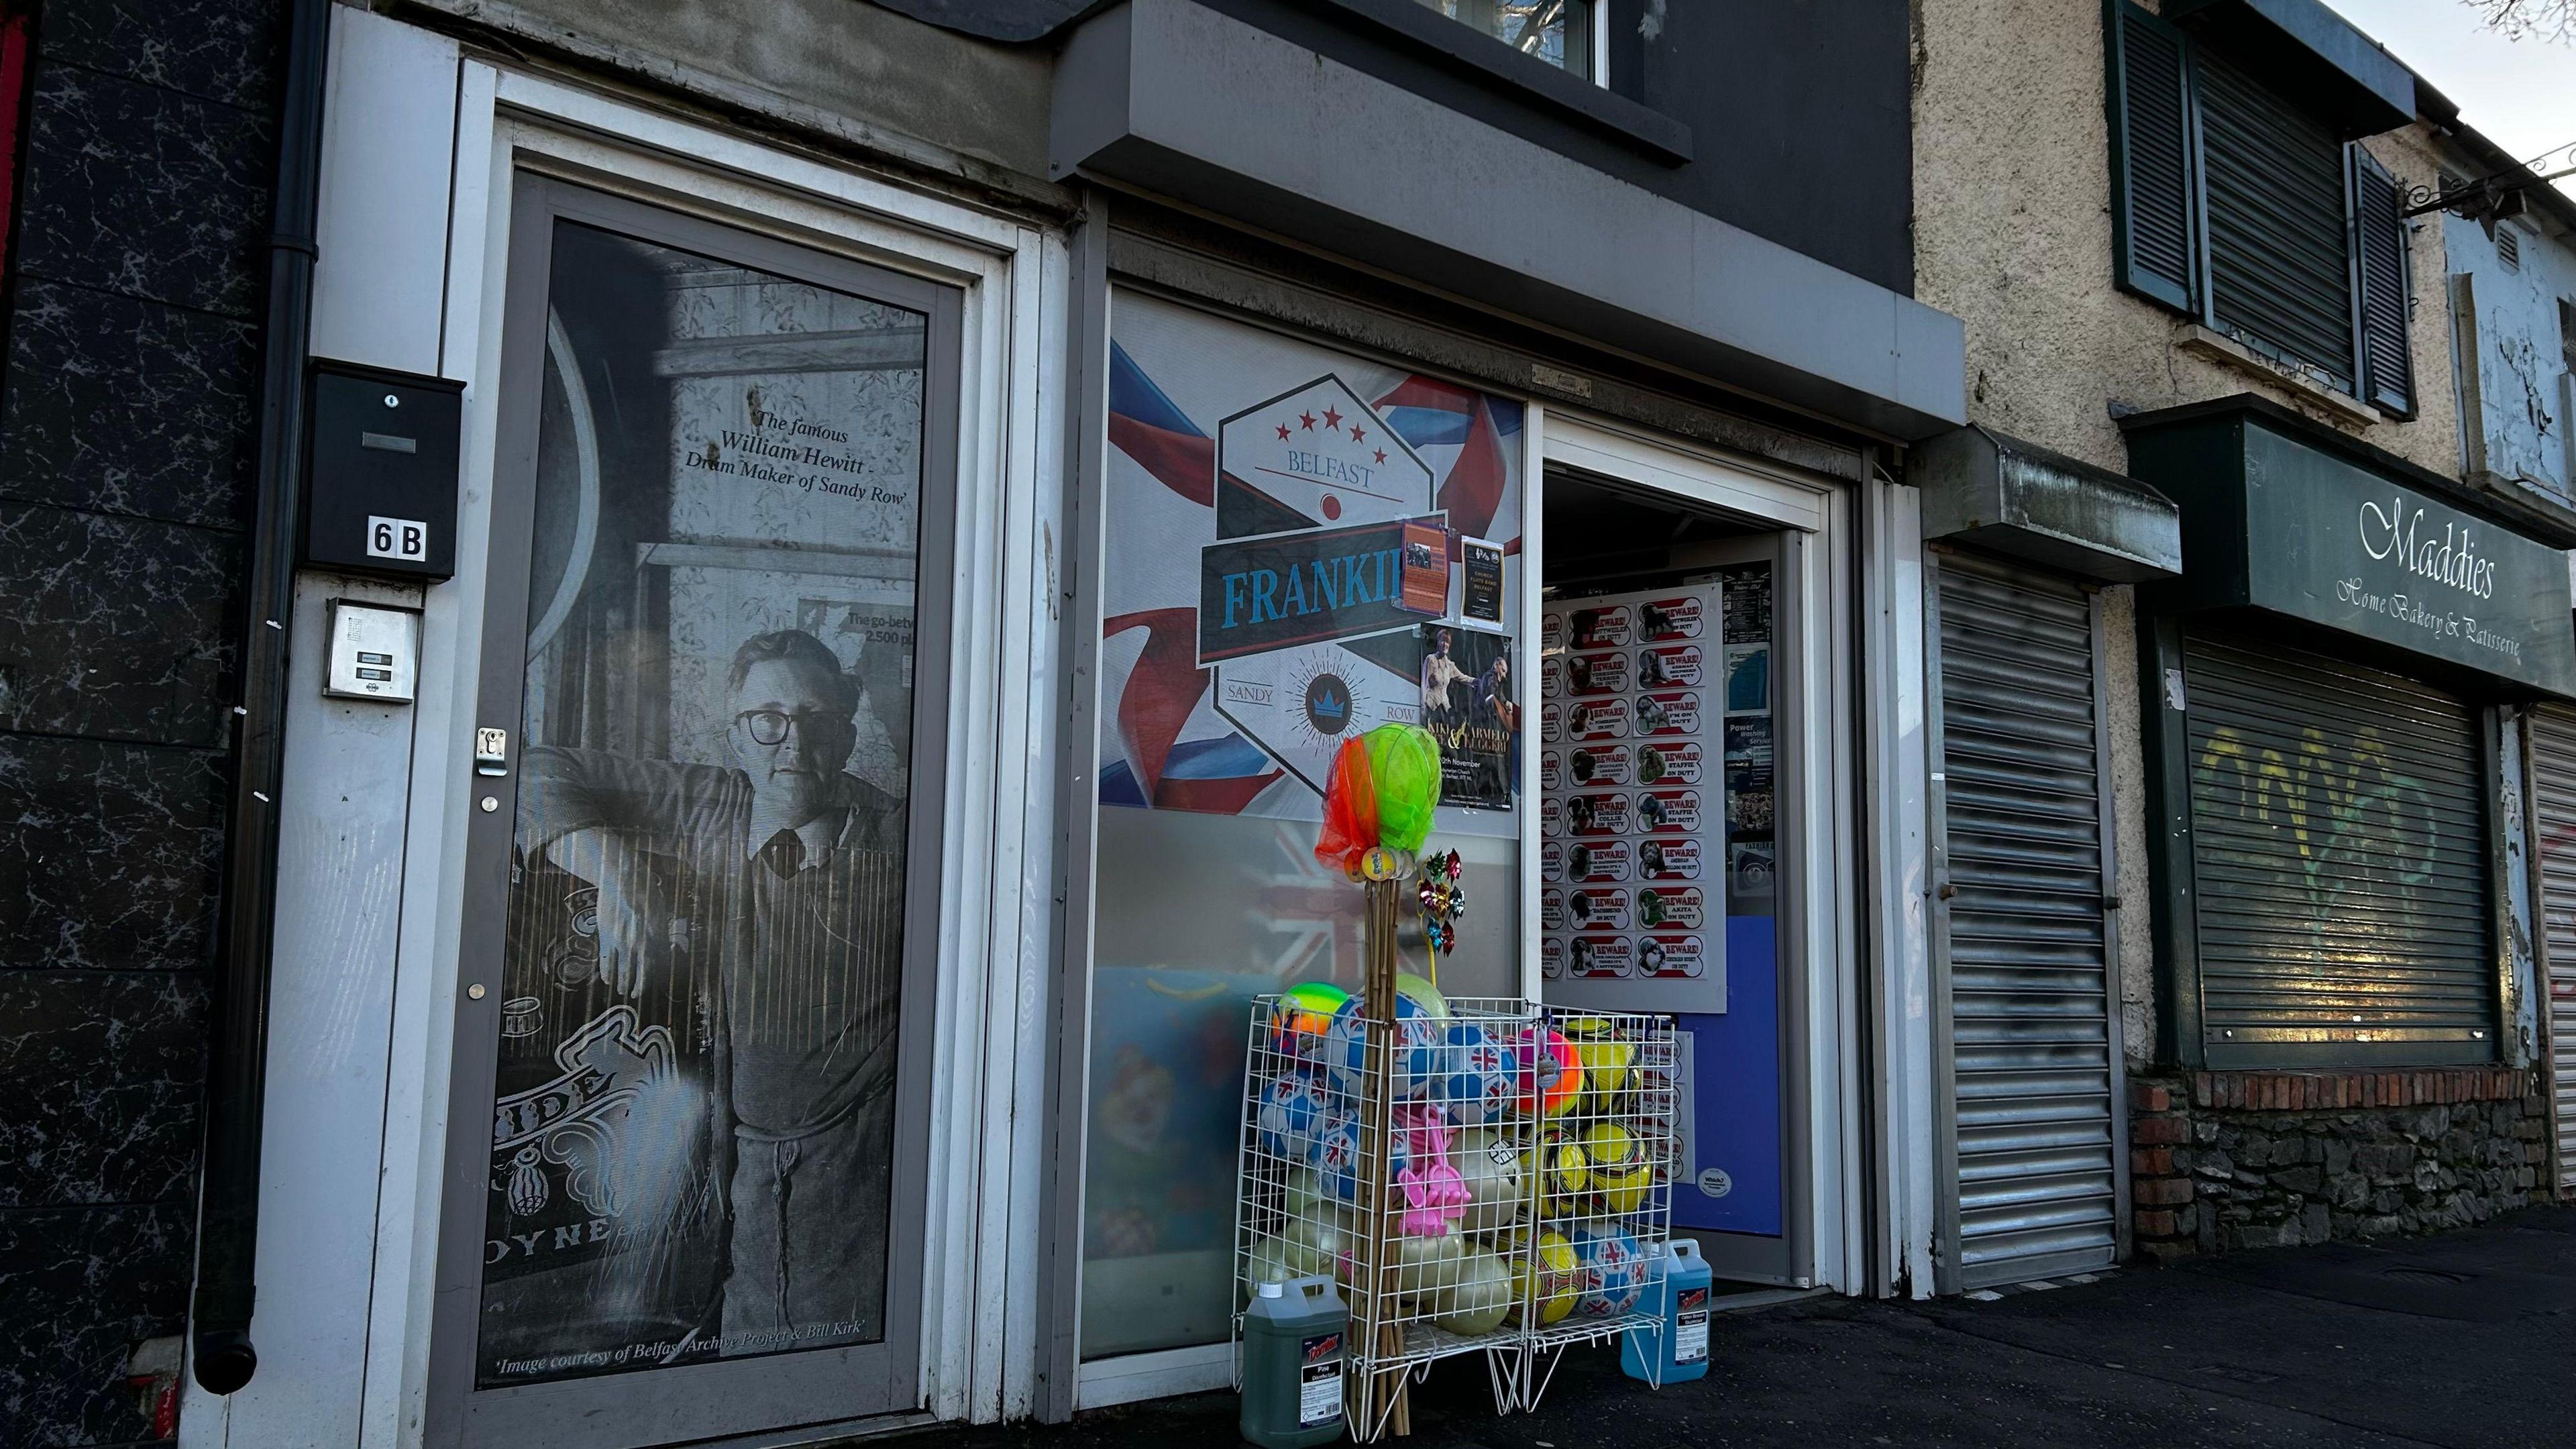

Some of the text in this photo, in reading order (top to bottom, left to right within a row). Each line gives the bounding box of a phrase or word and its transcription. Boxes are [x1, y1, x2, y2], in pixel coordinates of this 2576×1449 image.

[788, 417, 849, 443] famous
[720, 429, 798, 462] William
[804, 445, 865, 474] Hewitt
[1287, 450, 1375, 488] BELFAST
[686, 450, 735, 474] Drum
[740, 461, 795, 485] Maker
[798, 475, 816, 493] of
[818, 477, 866, 502] Sandy
[2359, 496, 2495, 599] Maddies
[1666, 606, 1699, 618] BEWARE!
[2336, 577, 2520, 657] Home Bakery & Patisserie
[848, 612, 869, 625] The
[1666, 655, 1699, 665] BEWARE!
[1593, 661, 1625, 672] BEWARE!
[1228, 685, 1273, 703] SANDY
[1663, 702, 1697, 712] BEWARE!
[1387, 706, 1415, 722] ROW
[1594, 708, 1626, 718] BEWARE!
[1468, 726, 1510, 742] ARMELO
[1452, 758, 1481, 768] November
[1597, 753, 1627, 763] BEWARE!
[1665, 752, 1700, 763] BEWARE!
[1595, 801, 1627, 812] BEWARE!
[1664, 800, 1697, 810] BEWARE!
[1594, 850, 1627, 861] BEWARE!
[1664, 849, 1698, 859] BEWARE!
[1595, 898, 1627, 908] BEWARE!
[1664, 896, 1701, 907] BEWARE!
[1596, 945, 1630, 956] BEWARE!
[1666, 945, 1699, 955] BEWARE!
[614, 1346, 633, 1364] of
[686, 1334, 739, 1353] Archive
[741, 1330, 787, 1348] Project
[791, 1327, 801, 1340] &
[806, 1324, 829, 1339] Bill
[1318, 1365, 1330, 1373] Pine
